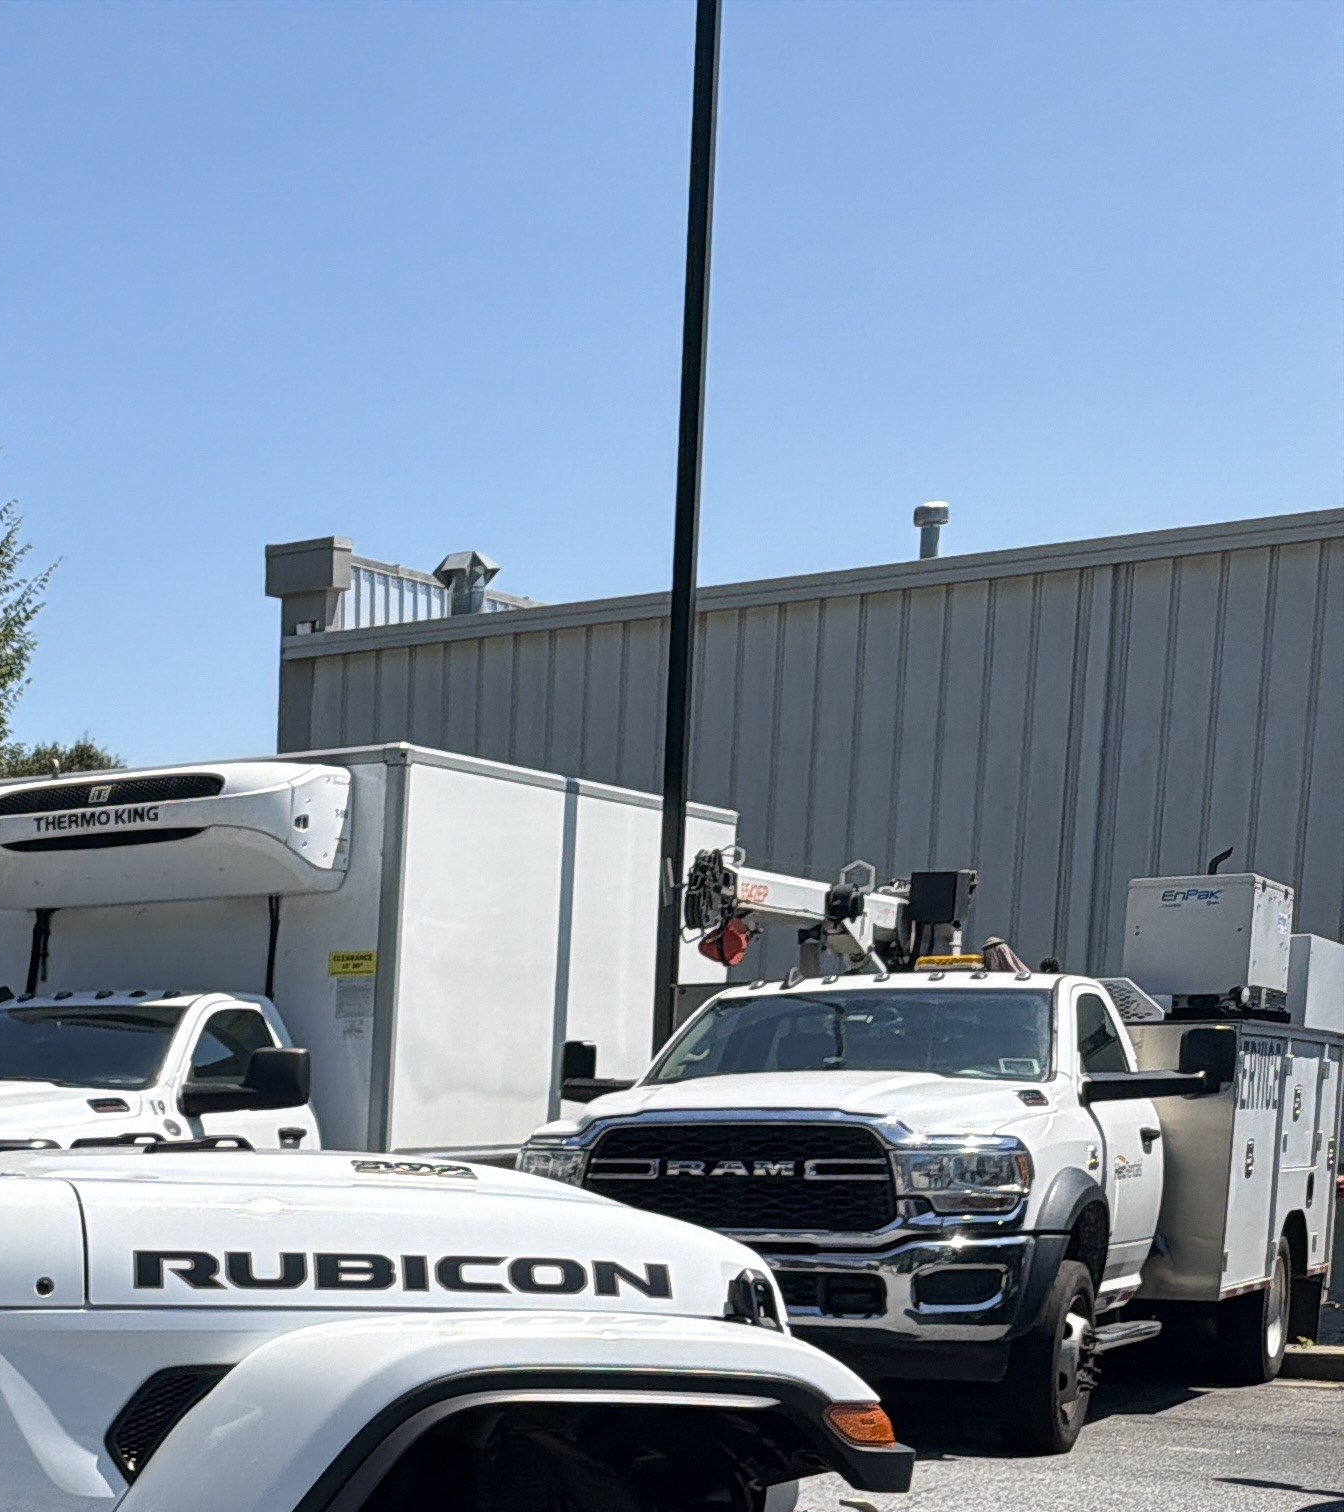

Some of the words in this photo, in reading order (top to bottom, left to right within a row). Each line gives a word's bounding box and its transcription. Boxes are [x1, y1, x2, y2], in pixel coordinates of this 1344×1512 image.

[33, 811, 111, 833] THERMO
[114, 806, 159, 826] KING
[1161, 889, 1223, 902] EnPak
[332, 953, 373, 961] CLEARANCE
[666, 1160, 796, 1177] RAM
[133, 1250, 674, 1300] RUBICON
